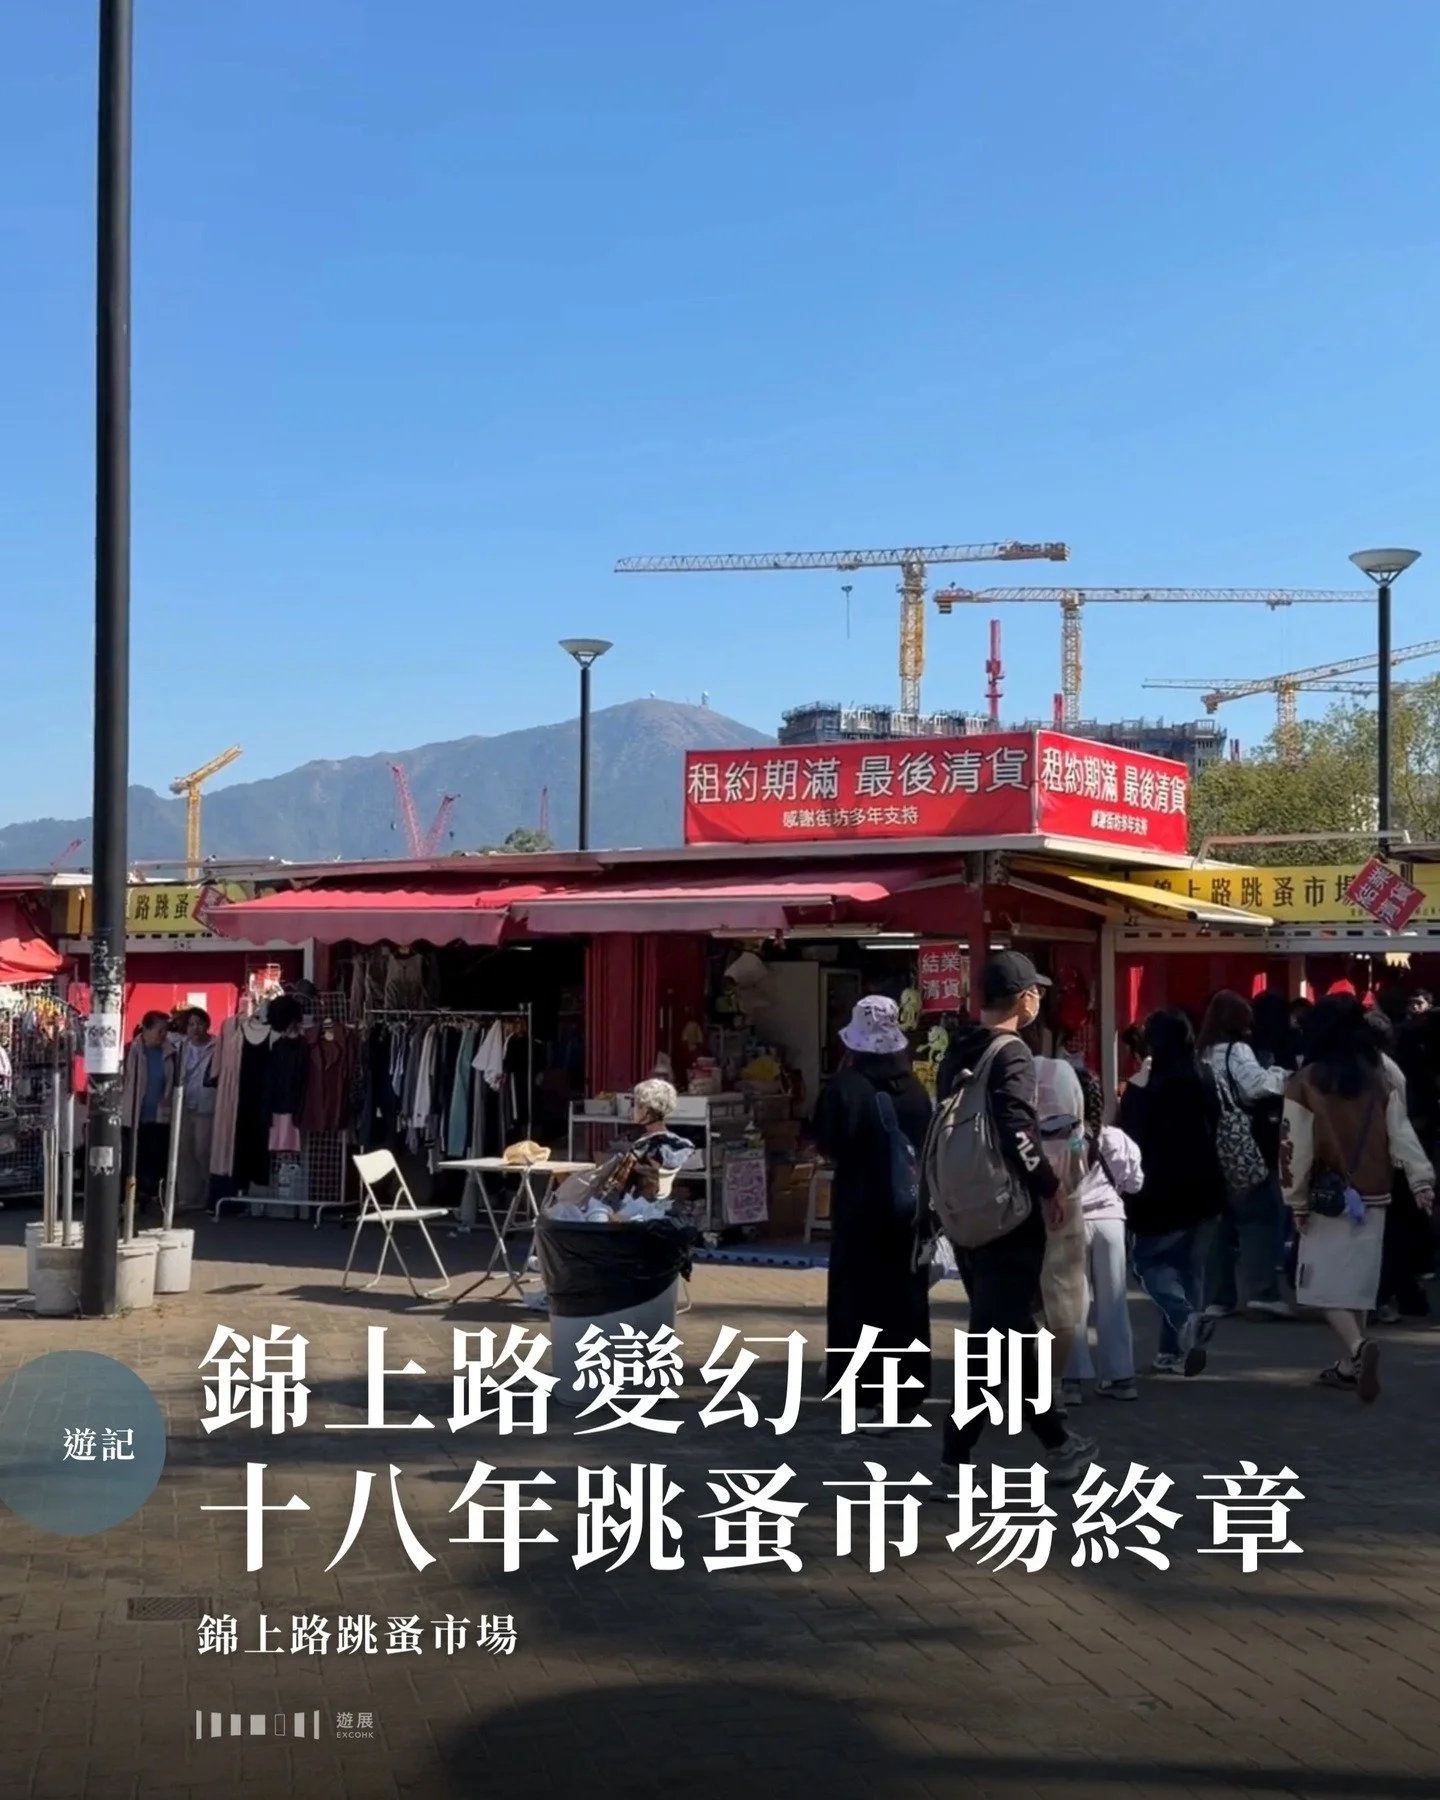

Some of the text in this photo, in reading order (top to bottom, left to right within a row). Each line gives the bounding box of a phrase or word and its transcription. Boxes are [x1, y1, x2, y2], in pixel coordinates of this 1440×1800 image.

[688, 745, 1030, 805] 租約期滿 最後清貨
[1040, 747, 1187, 816] 租約期滿 最後清貨
[782, 805, 919, 828] 感謝街坊多年支持
[127, 893, 200, 920] 路跳蚤
[921, 952, 961, 974] 結業
[921, 978, 961, 1000] 清貨
